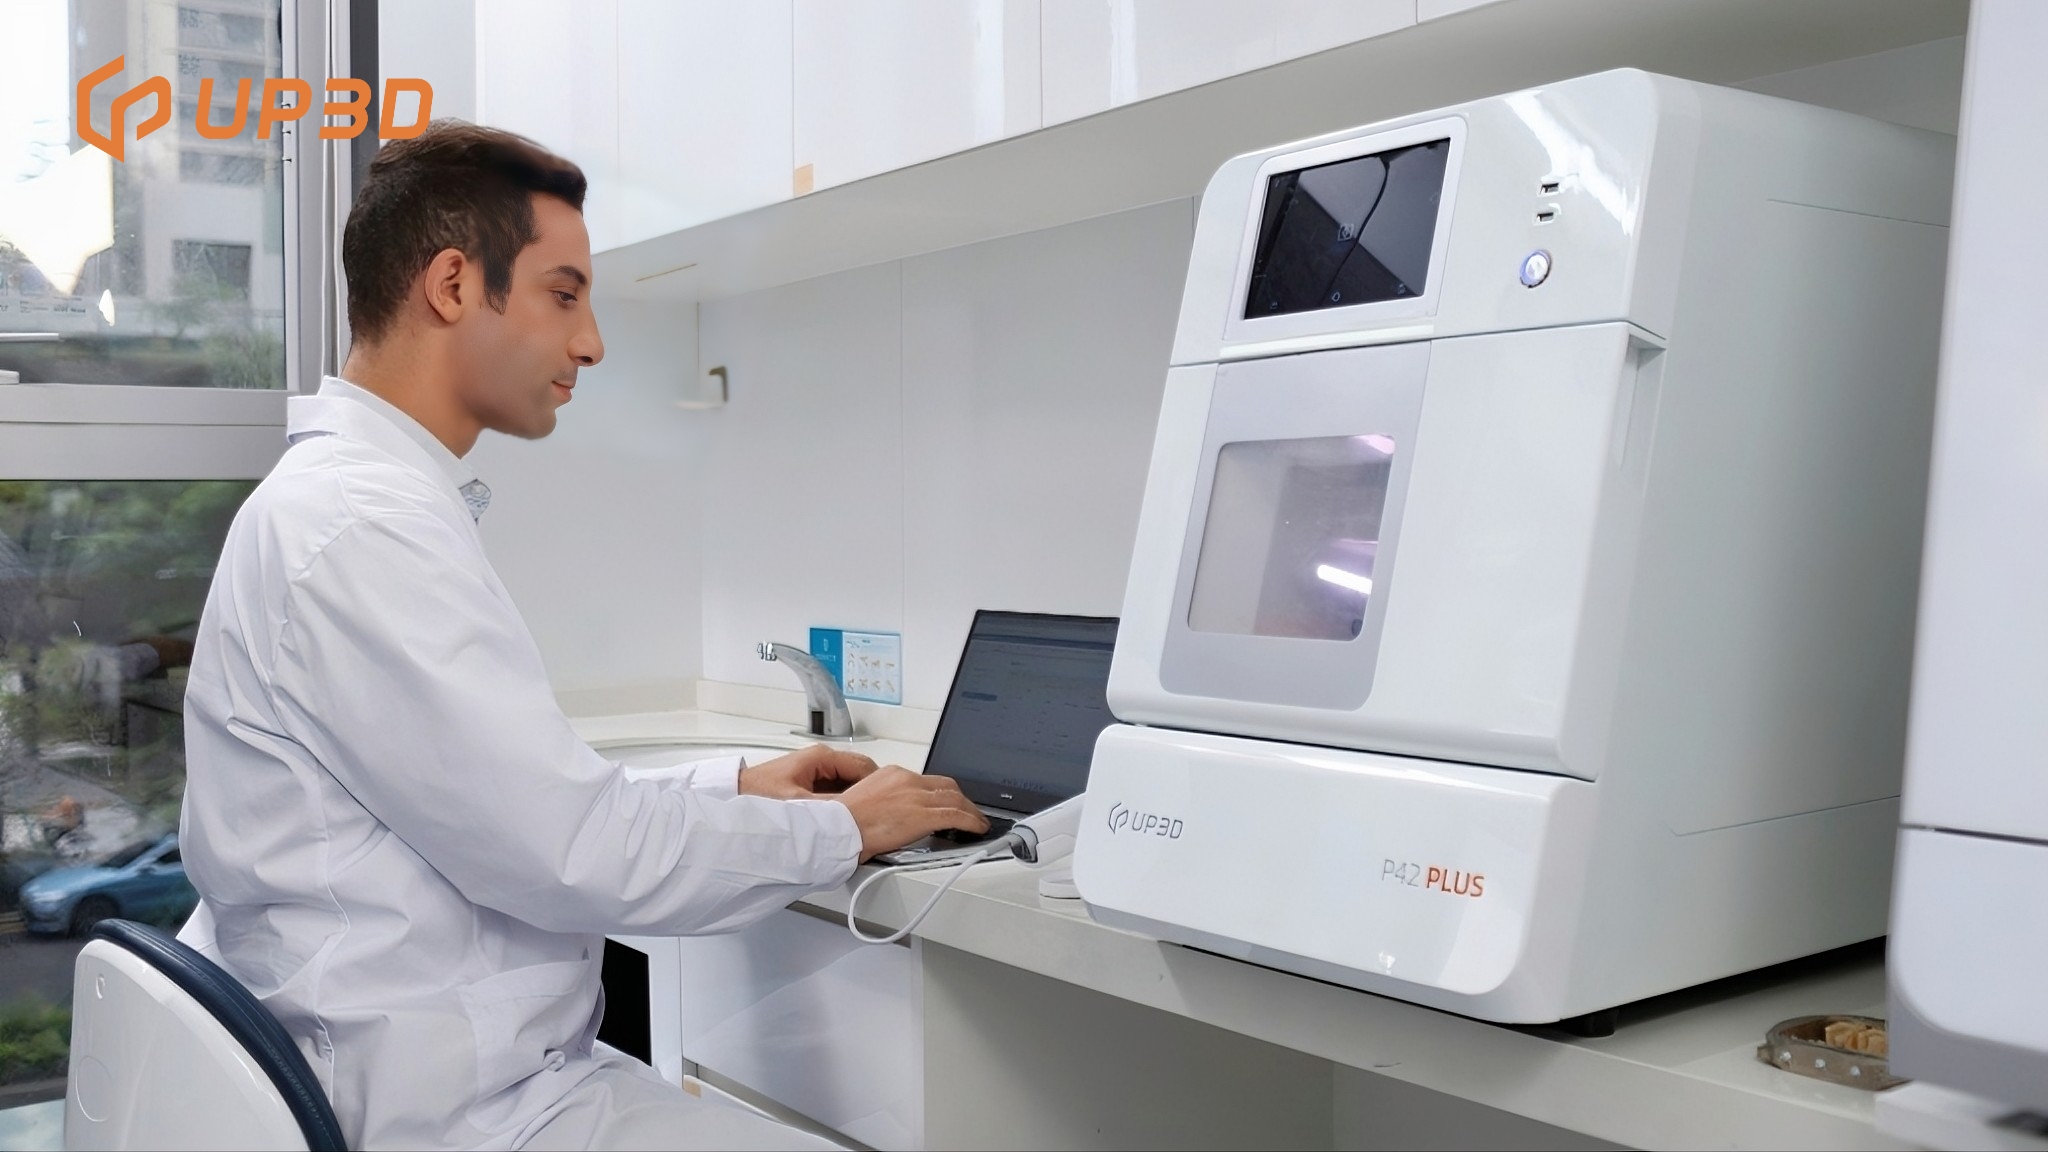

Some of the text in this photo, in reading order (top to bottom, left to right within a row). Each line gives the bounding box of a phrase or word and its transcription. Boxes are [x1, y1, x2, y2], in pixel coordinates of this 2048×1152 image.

[1132, 811, 1183, 839] UP3D
[1381, 858, 1485, 897] P42 PLUS
